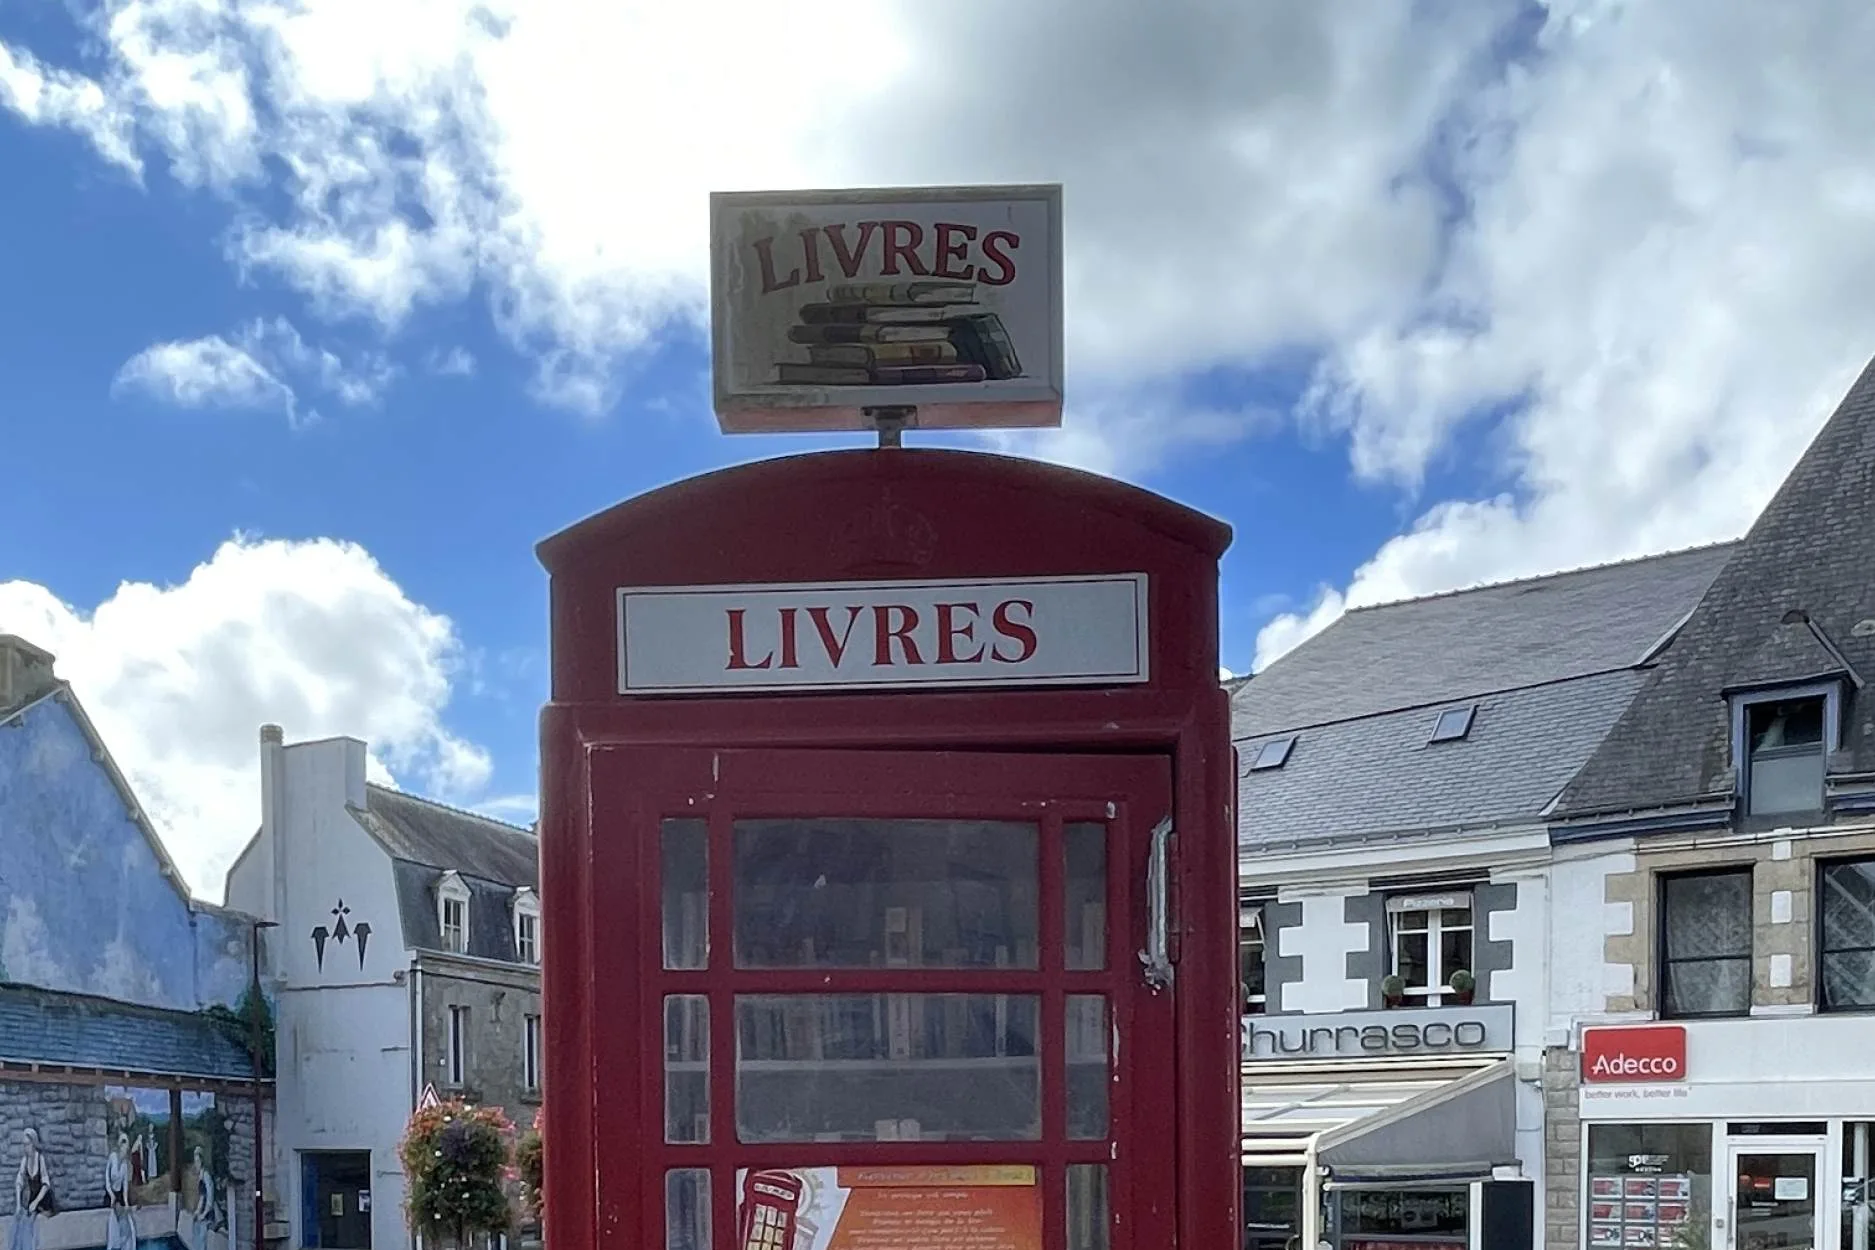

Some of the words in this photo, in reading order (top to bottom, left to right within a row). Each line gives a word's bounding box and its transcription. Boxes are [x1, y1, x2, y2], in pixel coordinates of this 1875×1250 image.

[753, 220, 1020, 294] LIVRES
[725, 600, 1038, 671] LIVRES
[1241, 1021, 1487, 1053] hurrasco
[1591, 1052, 1677, 1075] Adecco
